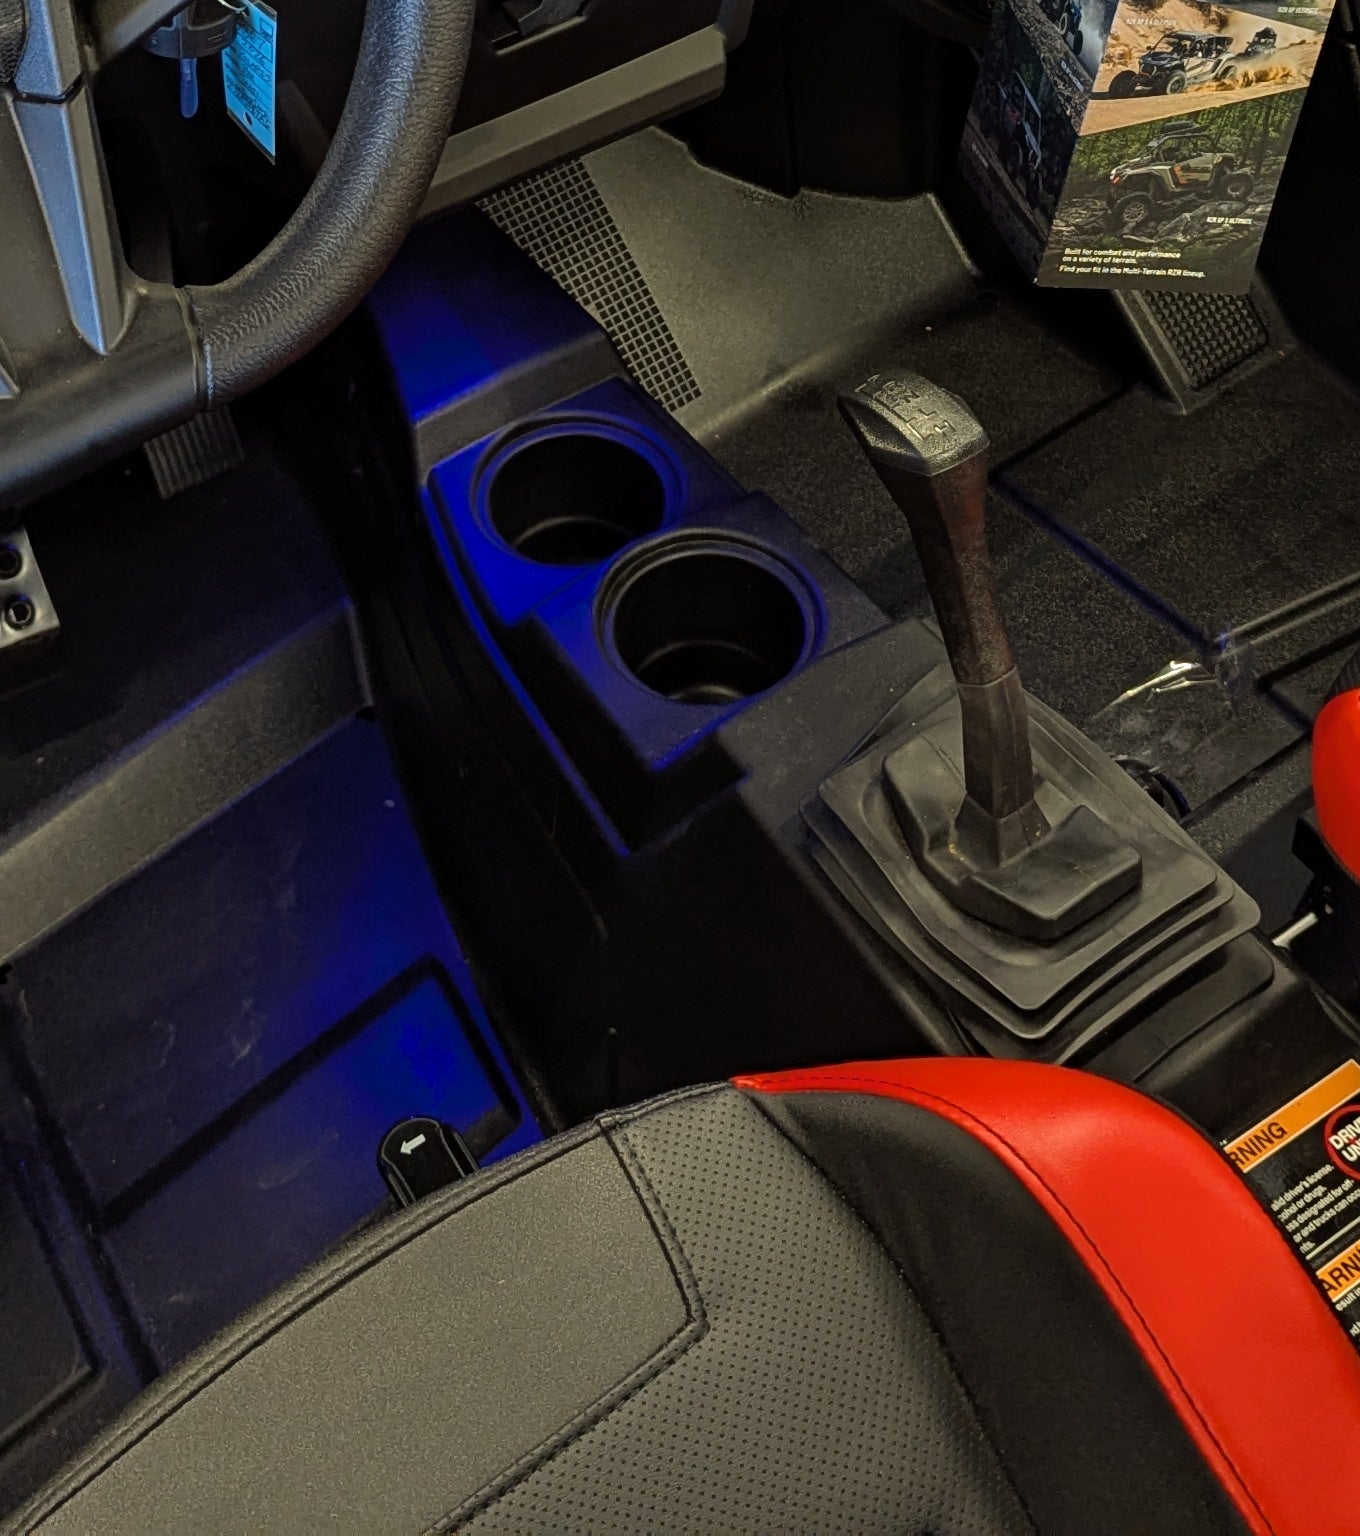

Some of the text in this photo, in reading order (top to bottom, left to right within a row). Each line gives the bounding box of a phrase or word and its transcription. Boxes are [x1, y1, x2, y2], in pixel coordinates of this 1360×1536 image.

[1064, 247, 1081, 255] Built
[1093, 248, 1122, 257] comfort
[1136, 250, 1181, 259] performance
[1078, 256, 1103, 264] variety
[1112, 256, 1138, 264] terrain.
[1059, 265, 1075, 273] Find
[1076, 266, 1092, 275] your
[1109, 266, 1122, 274] the
[1122, 267, 1167, 276] Multi-Terrain
[1167, 268, 1182, 276] RZR
[1182, 269, 1206, 278] lineup.
[1228, 1121, 1289, 1166] RNING
[1283, 1164, 1335, 1202] driver's license.
[1304, 1184, 1328, 1203] drugs.
[1297, 1194, 1335, 1224] designated
[1315, 1208, 1338, 1228] trucks
